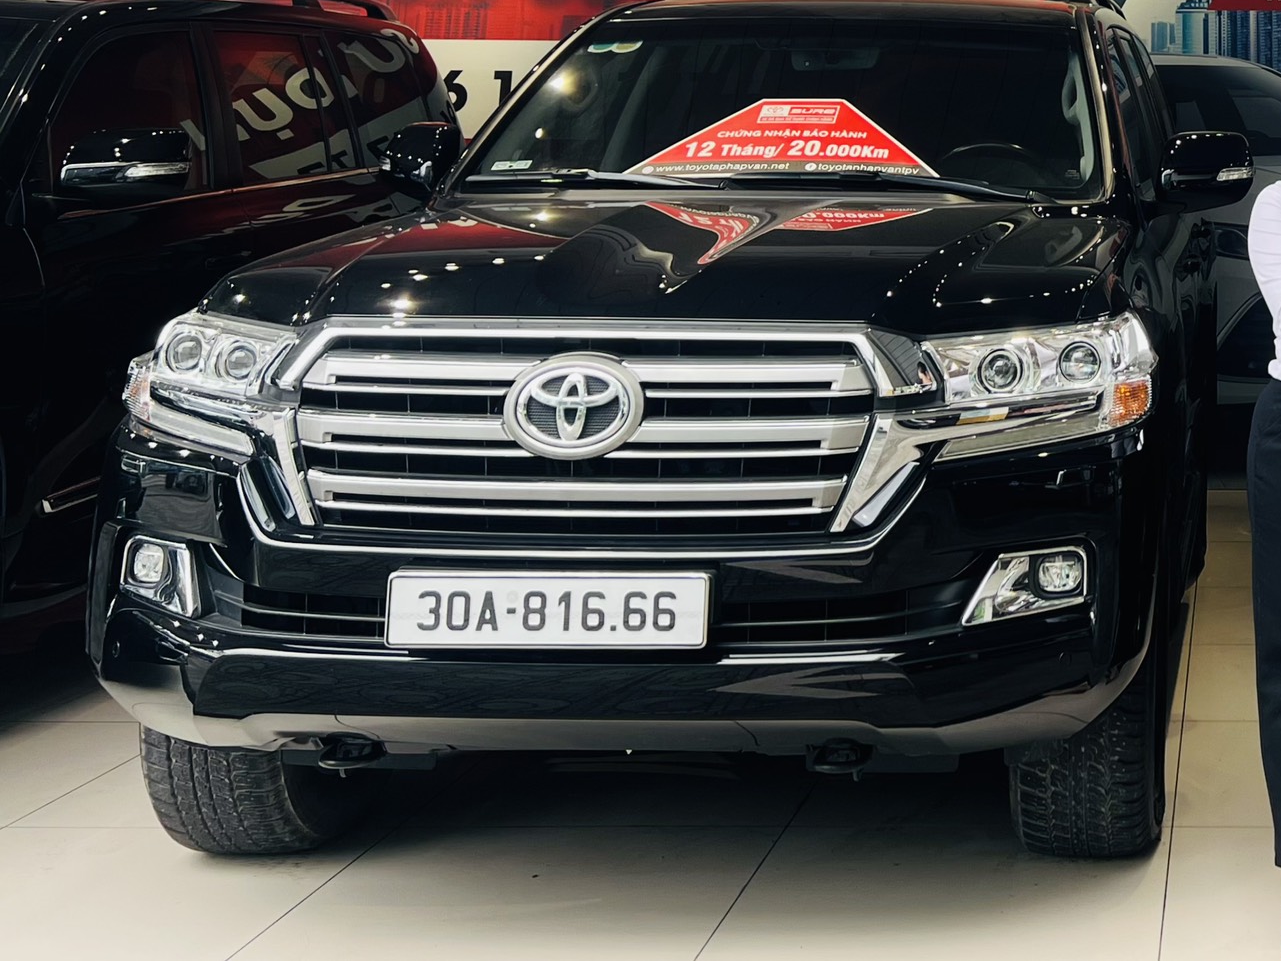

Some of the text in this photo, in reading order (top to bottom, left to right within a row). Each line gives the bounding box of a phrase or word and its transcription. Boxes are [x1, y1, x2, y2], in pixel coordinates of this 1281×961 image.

[685, 140, 889, 159] 12 Tháng/ 20.000Km
[656, 162, 790, 172] www.toyotaphapvan.net
[416, 591, 676, 632] 30A-816.66
